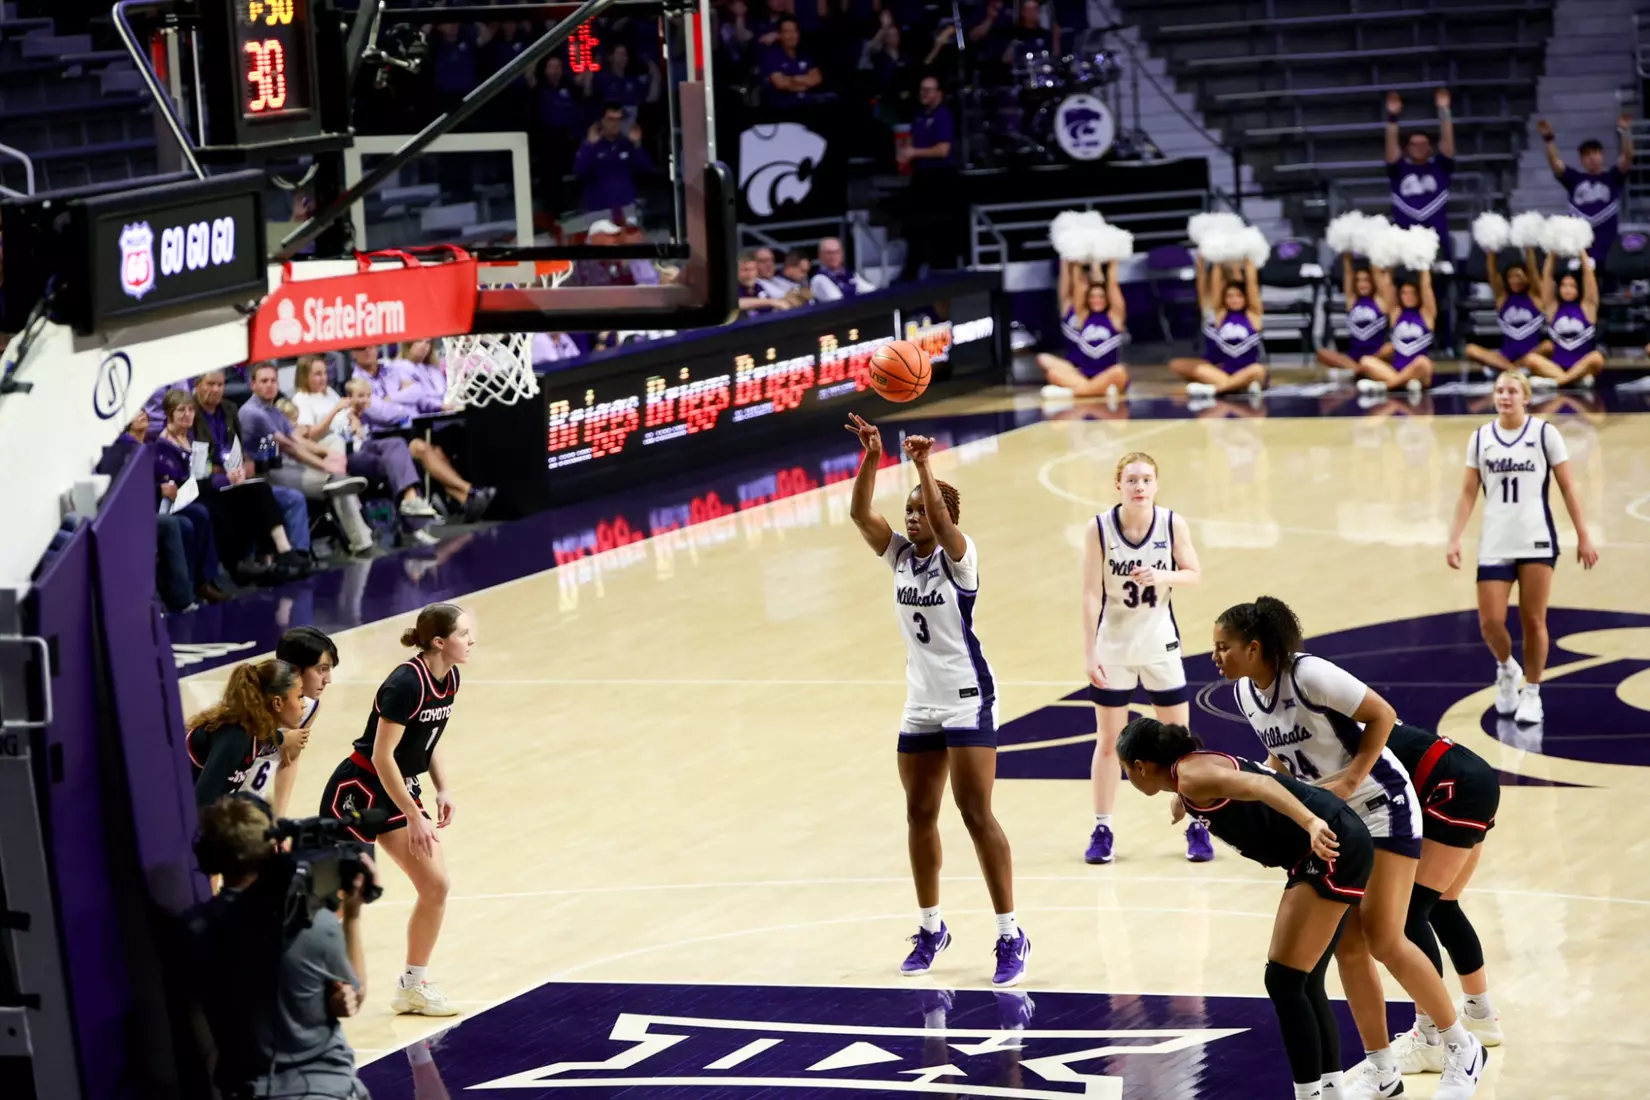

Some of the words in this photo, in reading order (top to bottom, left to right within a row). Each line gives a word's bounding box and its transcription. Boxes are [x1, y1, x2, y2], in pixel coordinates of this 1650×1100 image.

[243, 39, 285, 111] 30
[161, 226, 185, 276] GO
[186, 221, 210, 271] GO
[211, 216, 235, 265] GO
[1486, 458, 1536, 473] Wildcats
[1501, 476, 1519, 504] 11
[1109, 559, 1168, 576] Wilts
[897, 585, 946, 607] Wildcats
[1122, 580, 1158, 608] 34
[913, 612, 931, 644] 3
[425, 726, 440, 751] 1
[1257, 723, 1312, 749] Wildcats
[251, 760, 271, 791] 6
